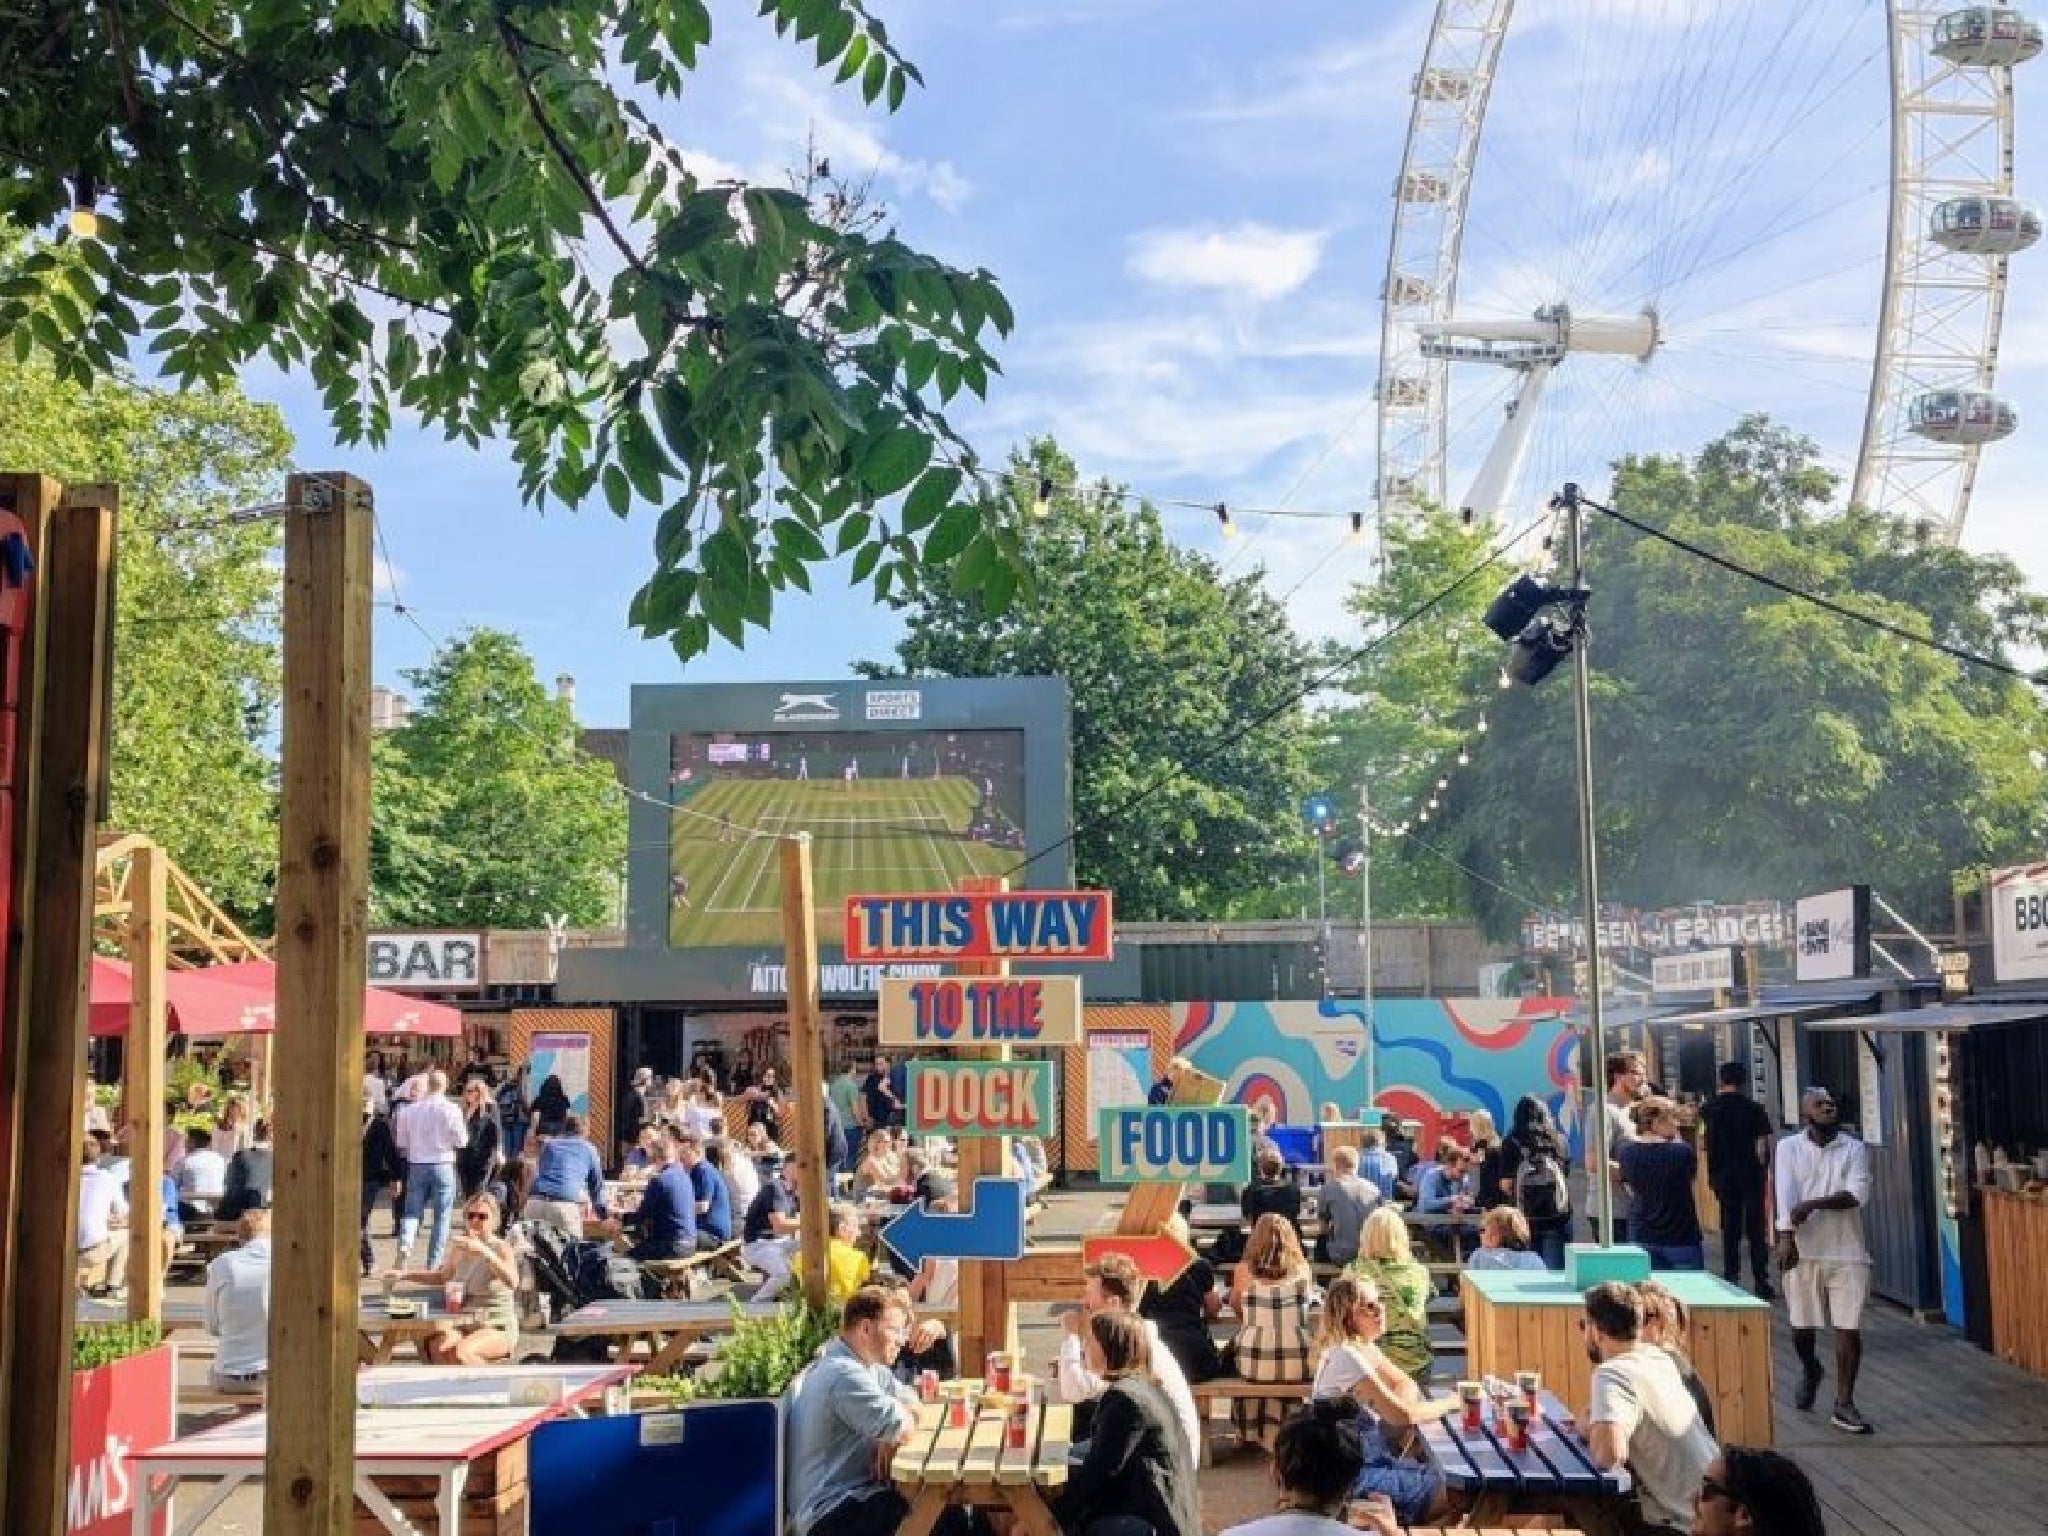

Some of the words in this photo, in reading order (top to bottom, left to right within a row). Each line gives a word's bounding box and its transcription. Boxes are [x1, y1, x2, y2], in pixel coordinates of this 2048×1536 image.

[856, 898, 974, 953] THIS
[986, 898, 1099, 953] WAY
[367, 940, 476, 979] BAR
[910, 982, 963, 1040] TO
[966, 982, 1044, 1040] THE
[916, 1067, 1040, 1130] DOCK
[1112, 1110, 1236, 1178] FOOD
